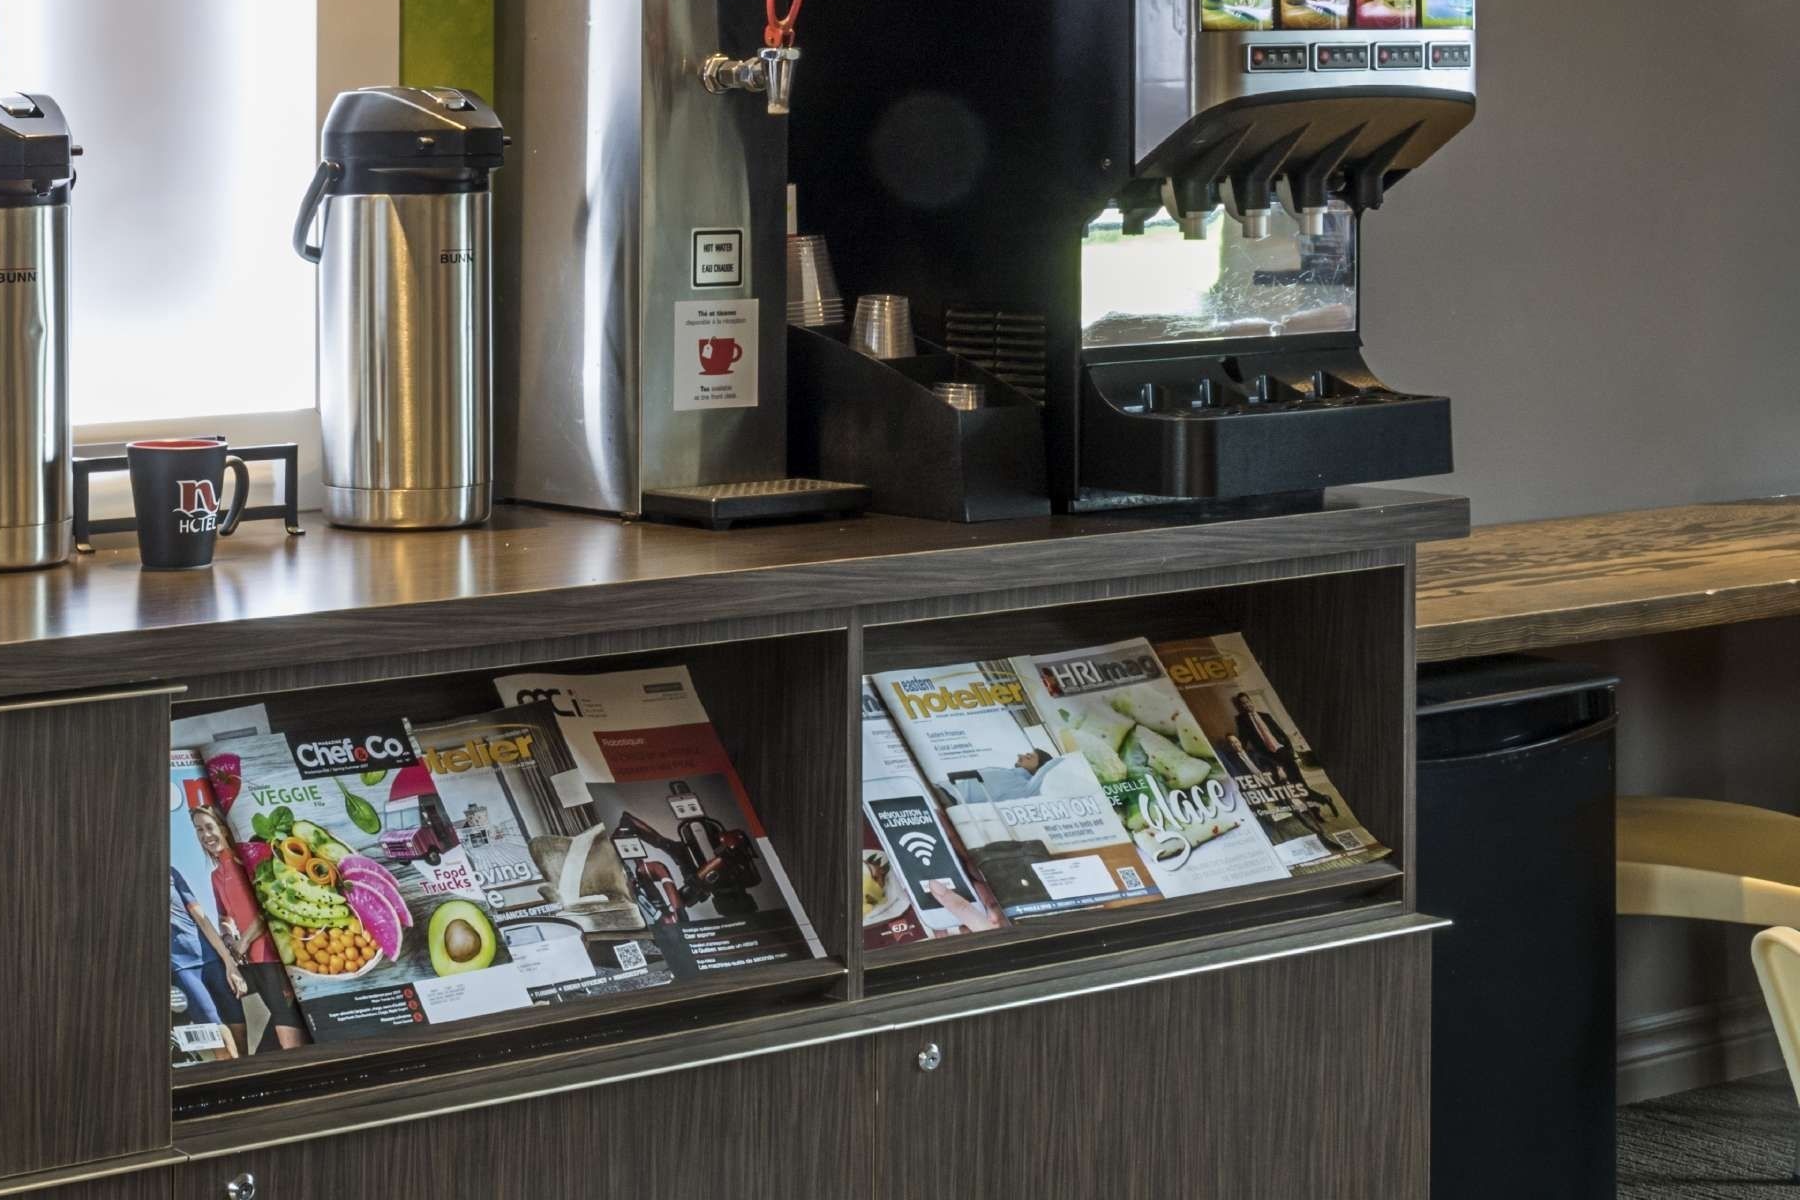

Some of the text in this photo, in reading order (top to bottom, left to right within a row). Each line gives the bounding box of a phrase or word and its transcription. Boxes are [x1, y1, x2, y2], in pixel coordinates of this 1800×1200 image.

[440, 253, 475, 265] BUNN
[701, 263, 713, 274] EAU
[1168, 656, 1241, 685] elier
[900, 676, 936, 692] eastern
[890, 681, 1024, 720] hotelier
[425, 733, 534, 775] telier
[1100, 778, 1147, 797] OUVELLE
[1235, 772, 1276, 791] TENT
[251, 785, 322, 807] VEGGIE
[1000, 796, 1102, 827] DREAM ON
[1138, 773, 1237, 872] glace
[433, 865, 467, 881] Food
[472, 861, 533, 886] oving
[419, 877, 472, 895] Trucks
